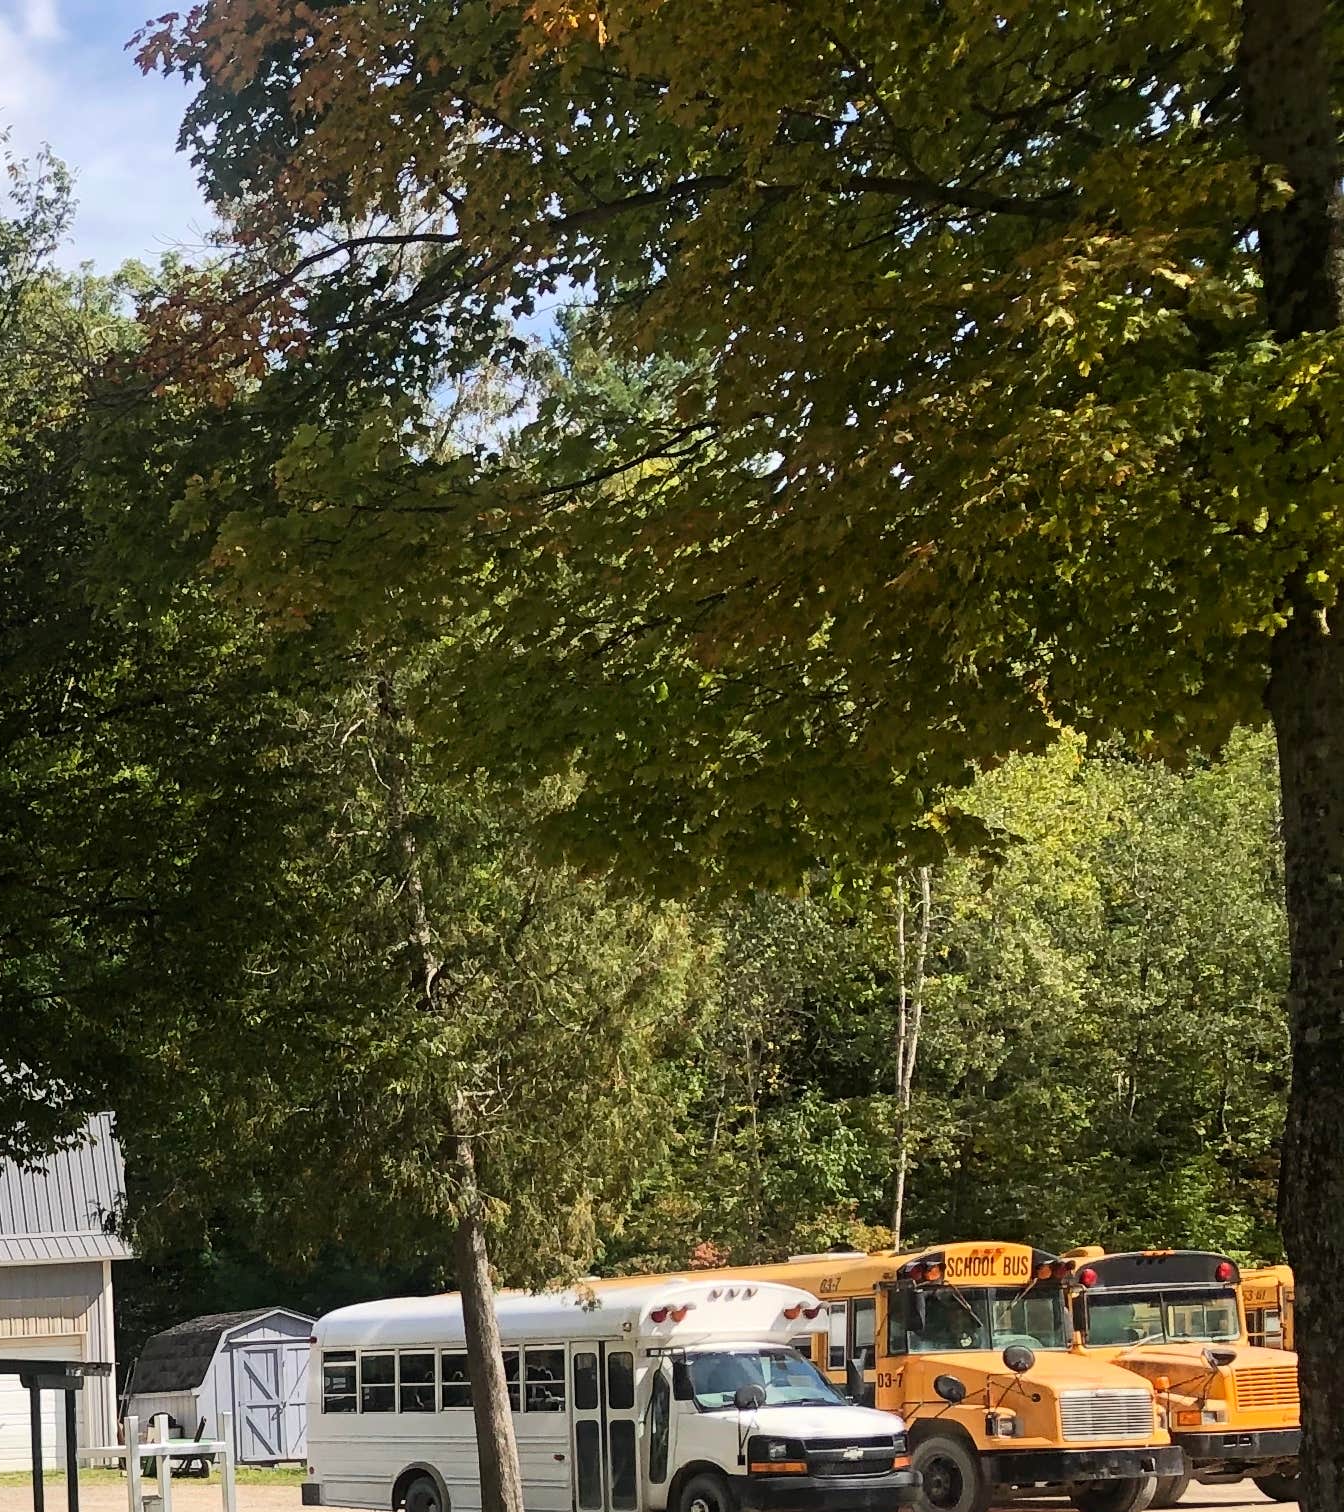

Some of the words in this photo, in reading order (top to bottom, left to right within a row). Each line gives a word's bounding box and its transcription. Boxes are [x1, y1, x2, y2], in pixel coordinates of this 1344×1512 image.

[946, 1257, 996, 1278] SCHOOL
[1003, 1255, 1029, 1276] BUS
[877, 1372, 904, 1388] 03-7
